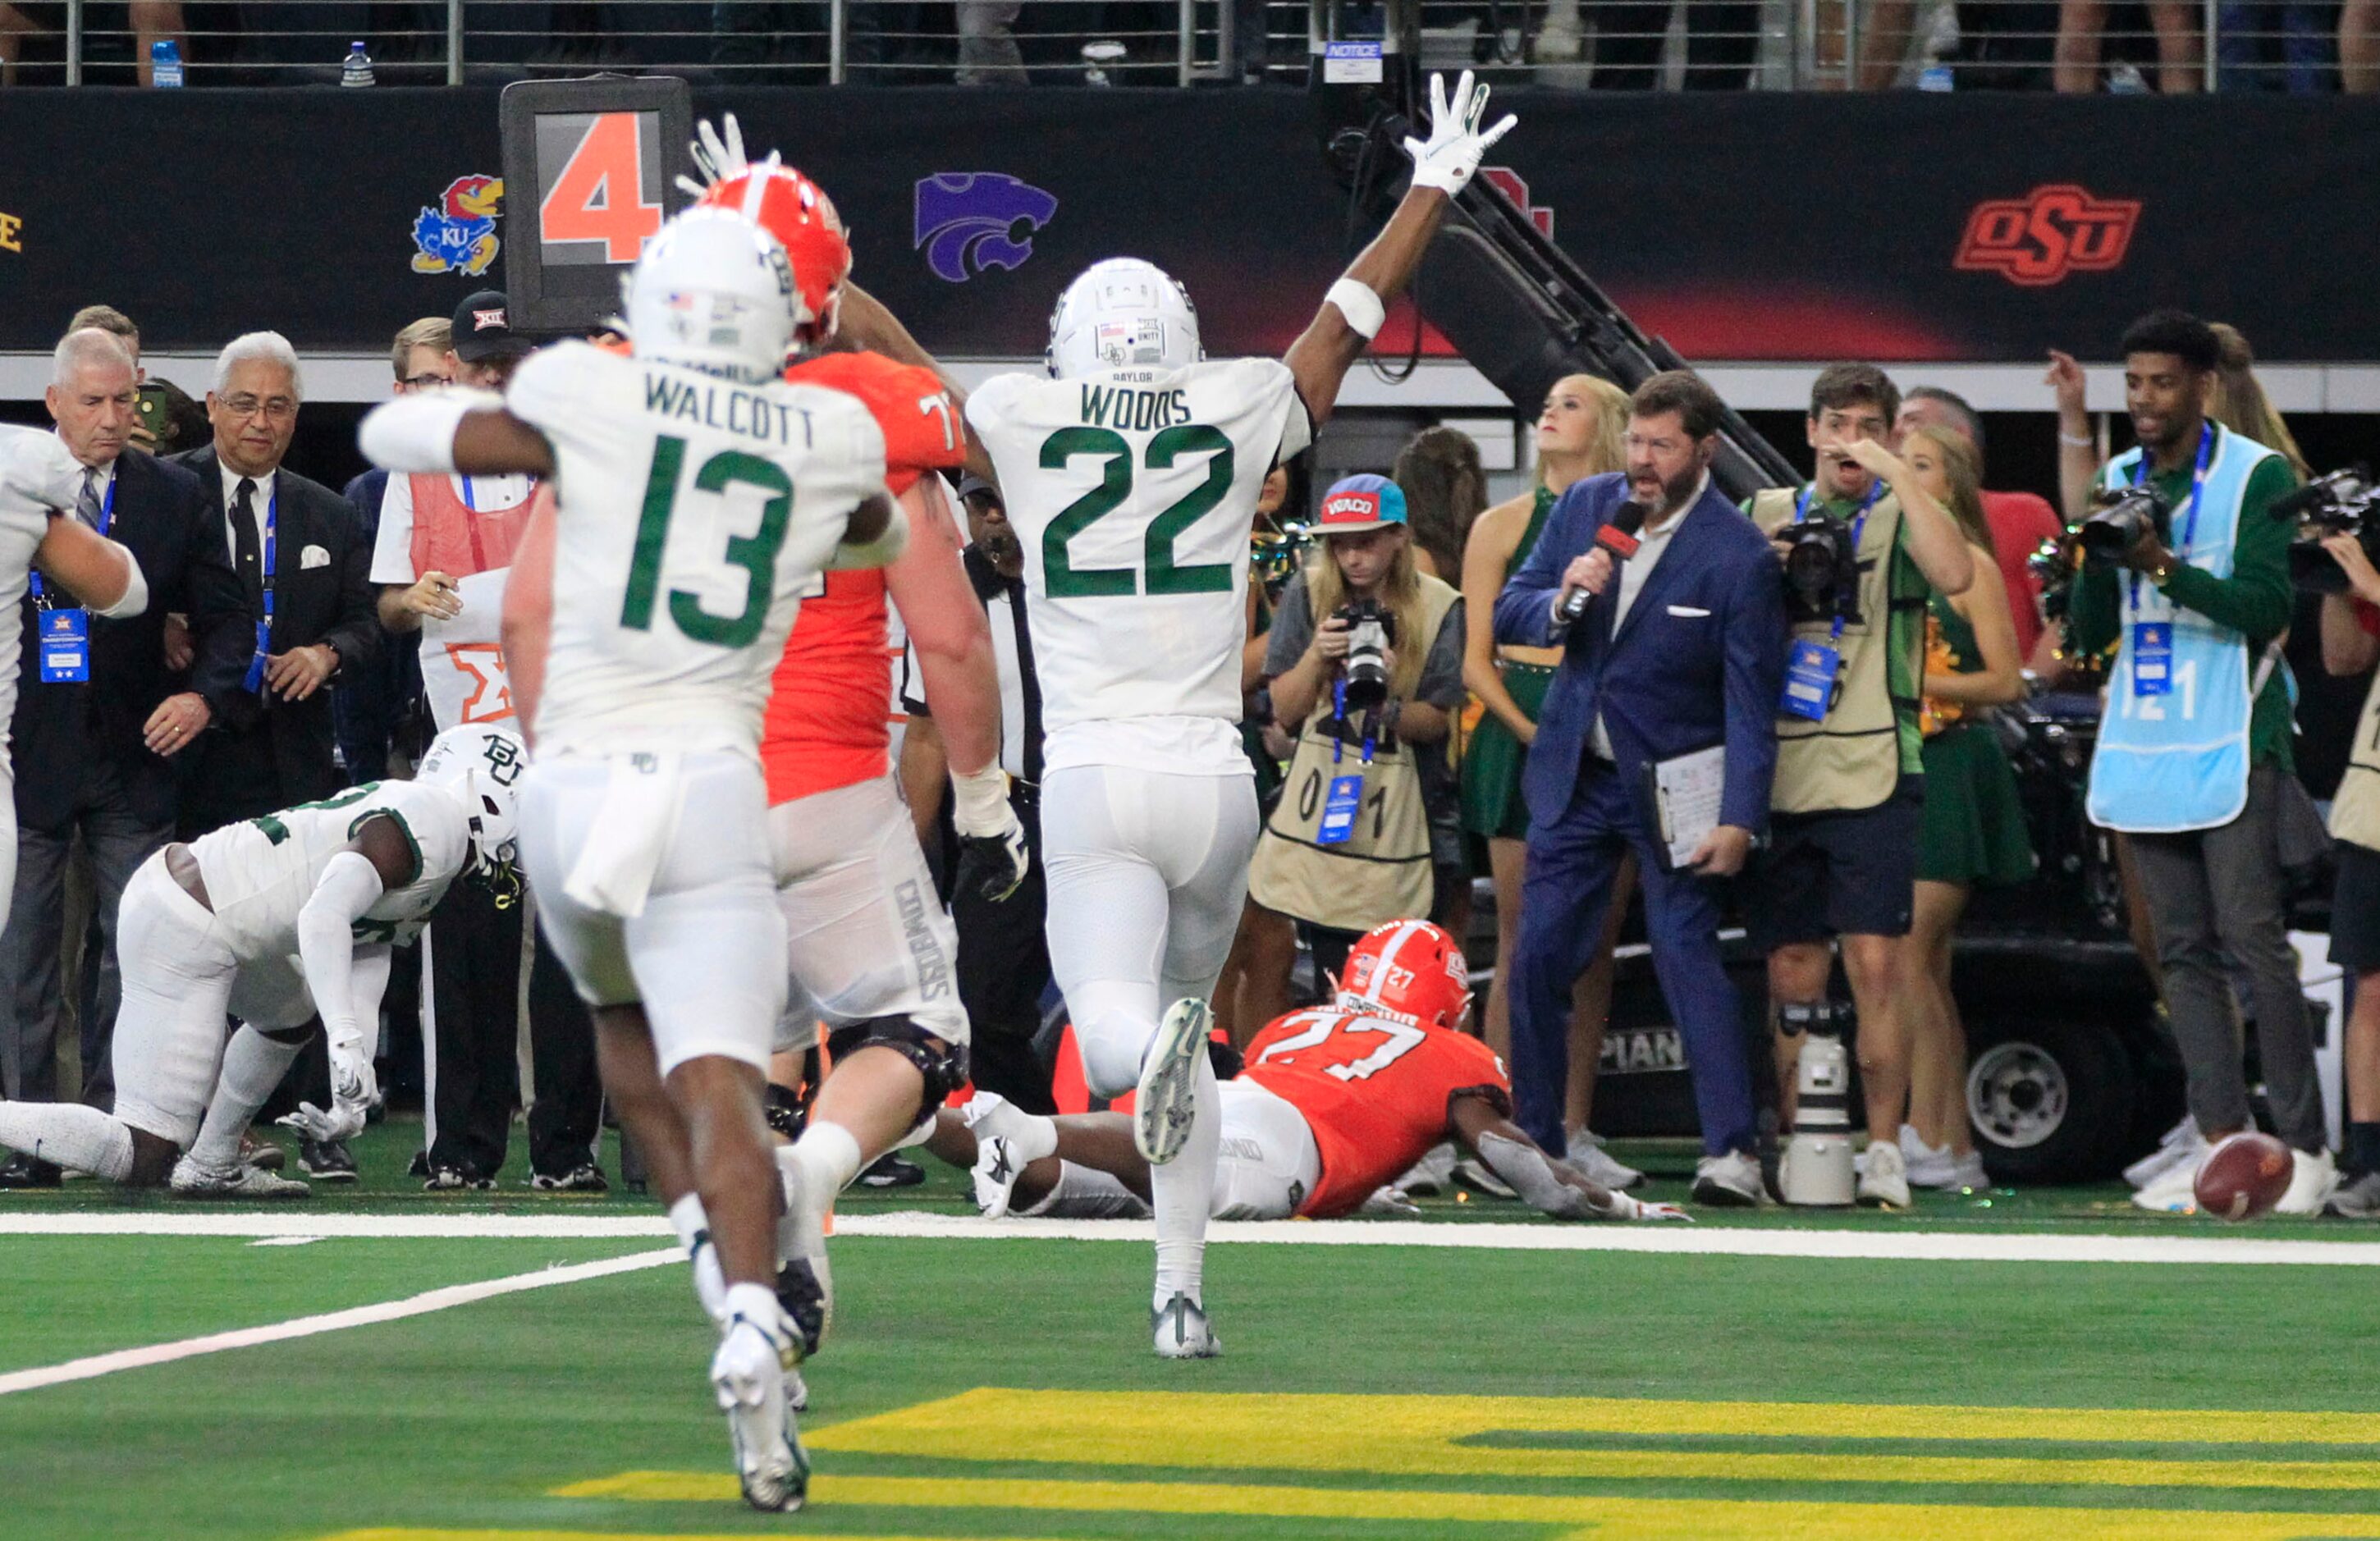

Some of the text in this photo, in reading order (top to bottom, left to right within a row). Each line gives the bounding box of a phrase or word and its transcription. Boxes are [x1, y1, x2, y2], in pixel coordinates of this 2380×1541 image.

[1330, 44, 1380, 57] NOTICE
[540, 112, 663, 263] 4
[442, 228, 469, 248] KU
[1953, 185, 2141, 285] OSU
[646, 372, 812, 450] WALCOTT
[1081, 383, 1192, 432] WOODS
[620, 433, 794, 650] 13
[1039, 424, 1234, 599] 22
[1328, 498, 1373, 515] WACO
[894, 878, 950, 1003] COWBOYS
[1388, 965, 1416, 990] 27
[1256, 1010, 1428, 1082] 27
